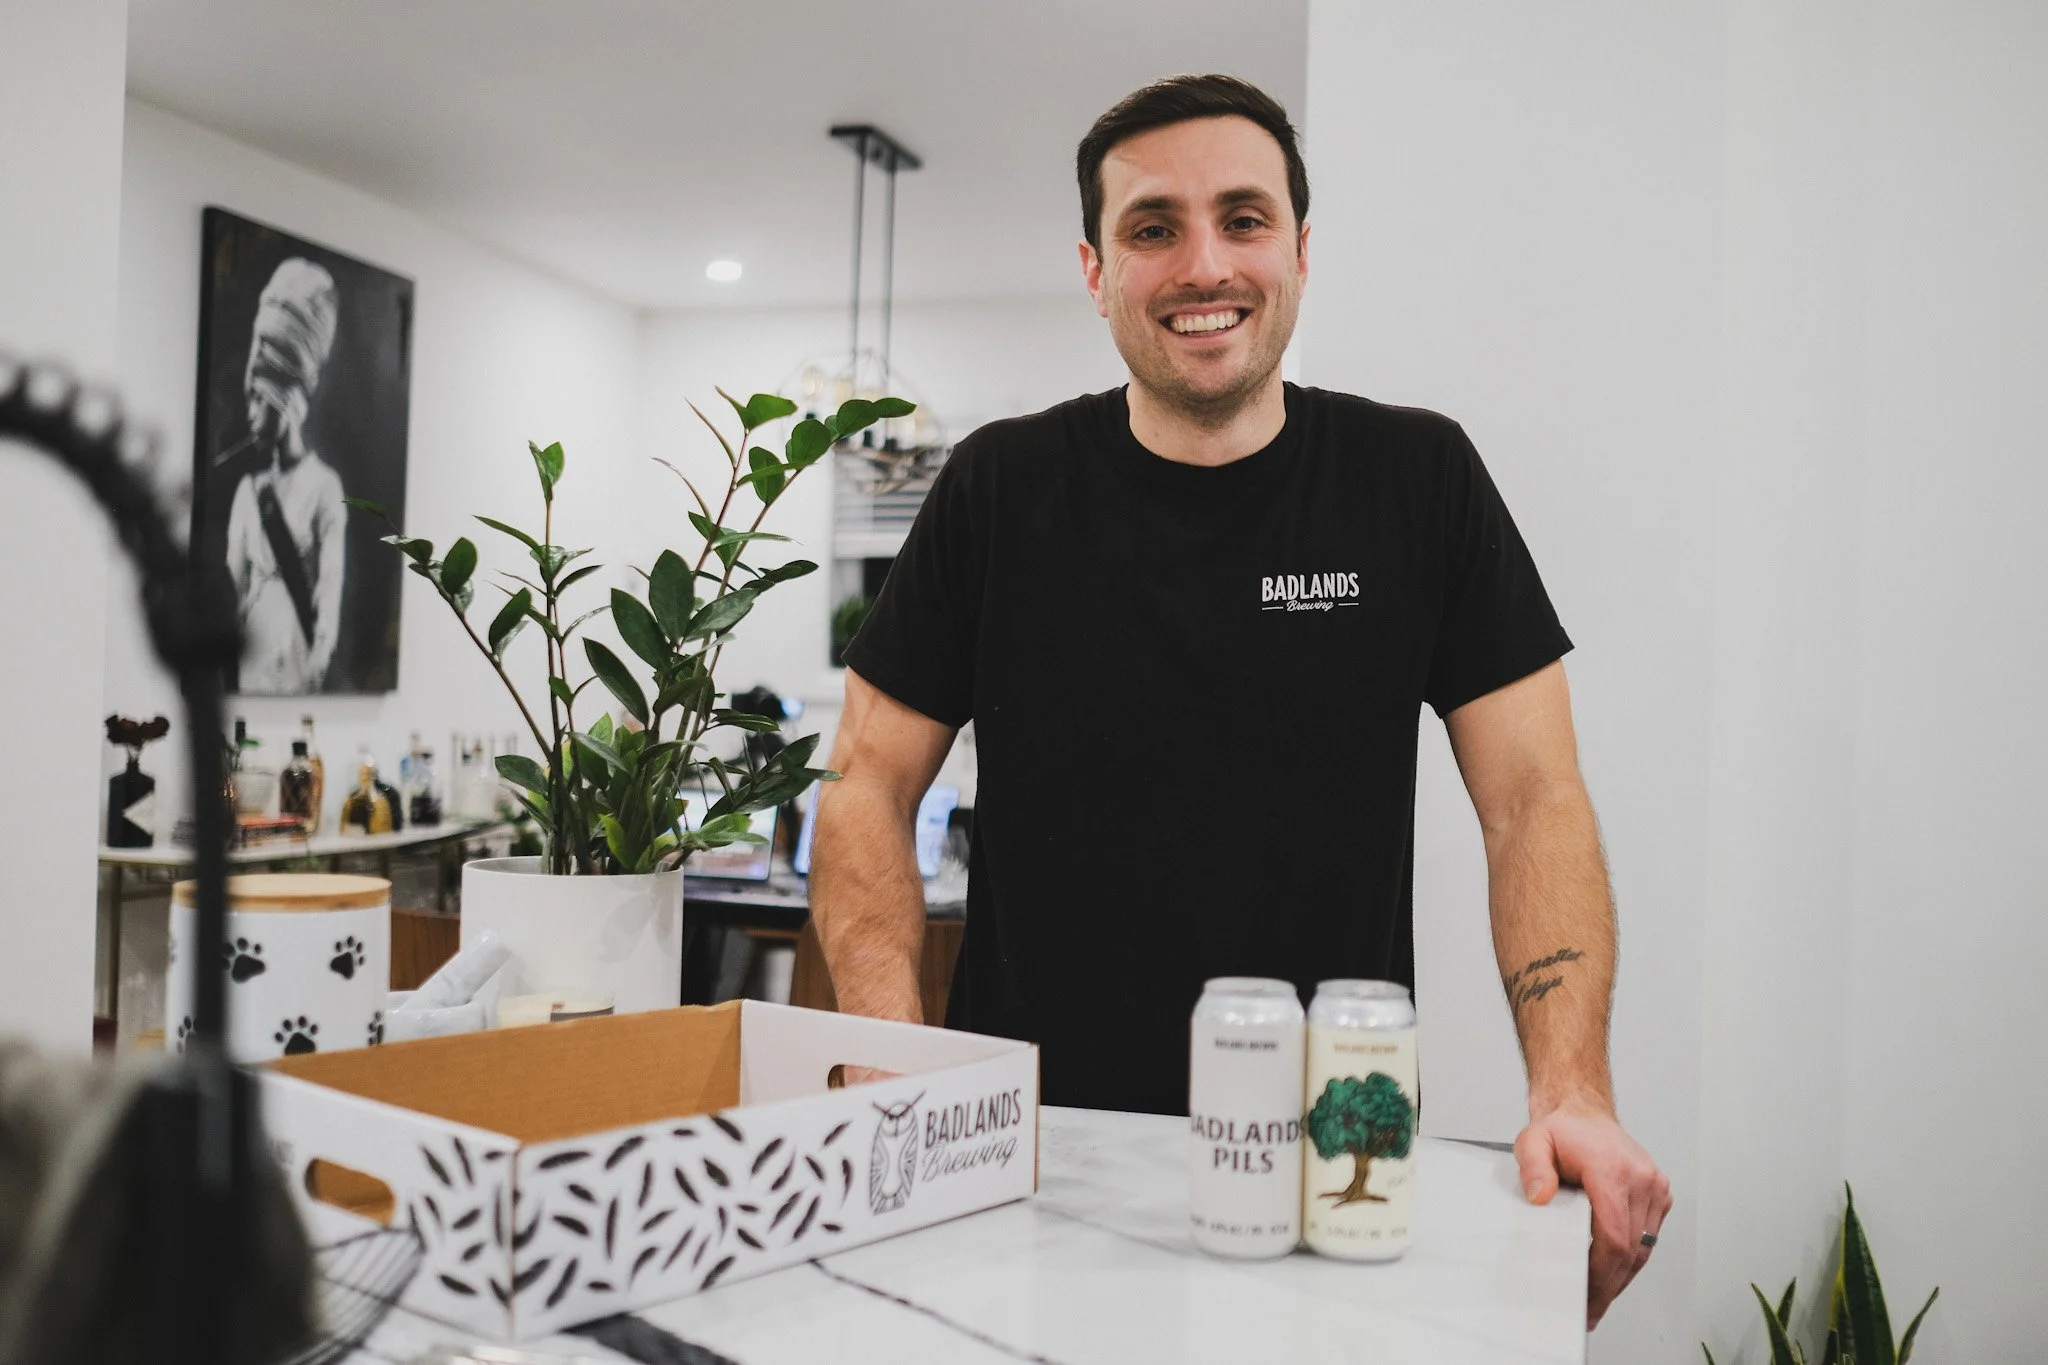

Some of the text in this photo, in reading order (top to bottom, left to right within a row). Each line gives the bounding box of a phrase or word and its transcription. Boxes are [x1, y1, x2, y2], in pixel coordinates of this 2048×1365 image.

[1261, 572, 1360, 602] BADLANDS
[1286, 600, 1334, 612] Brewing
[925, 1088, 1022, 1149] BADLANDS
[921, 1136, 1020, 1183] Brewing
[1214, 1147, 1274, 1174] PILS
